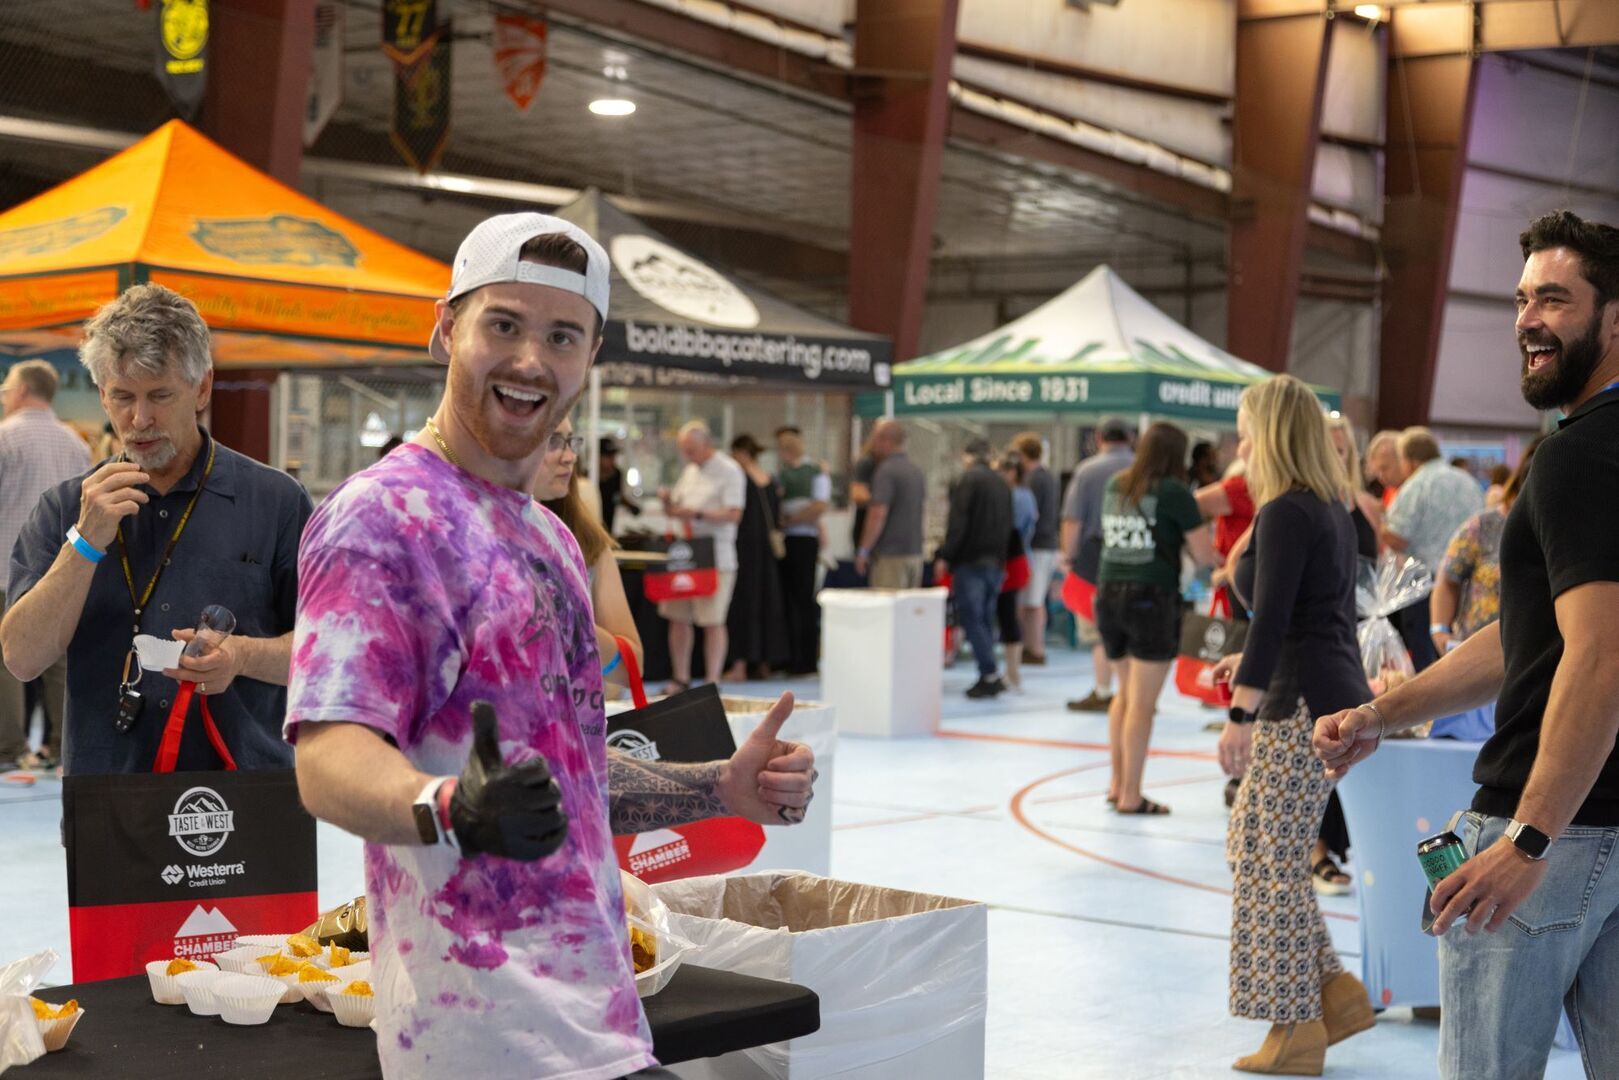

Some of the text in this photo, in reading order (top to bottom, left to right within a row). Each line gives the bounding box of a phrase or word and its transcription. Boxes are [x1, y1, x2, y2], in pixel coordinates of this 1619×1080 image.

[625, 321, 871, 378] boldbbqcatering.com
[904, 375, 1090, 406] Local Since 1931
[1158, 380, 1242, 409] credit uni
[1103, 530, 1157, 549] OCAL
[173, 816, 200, 833] TASTE
[204, 813, 229, 829] WEST
[630, 844, 689, 871] CHAMBER
[185, 863, 245, 879] Westerra
[188, 878, 226, 888] Credit Union
[173, 937, 200, 945] WEST
